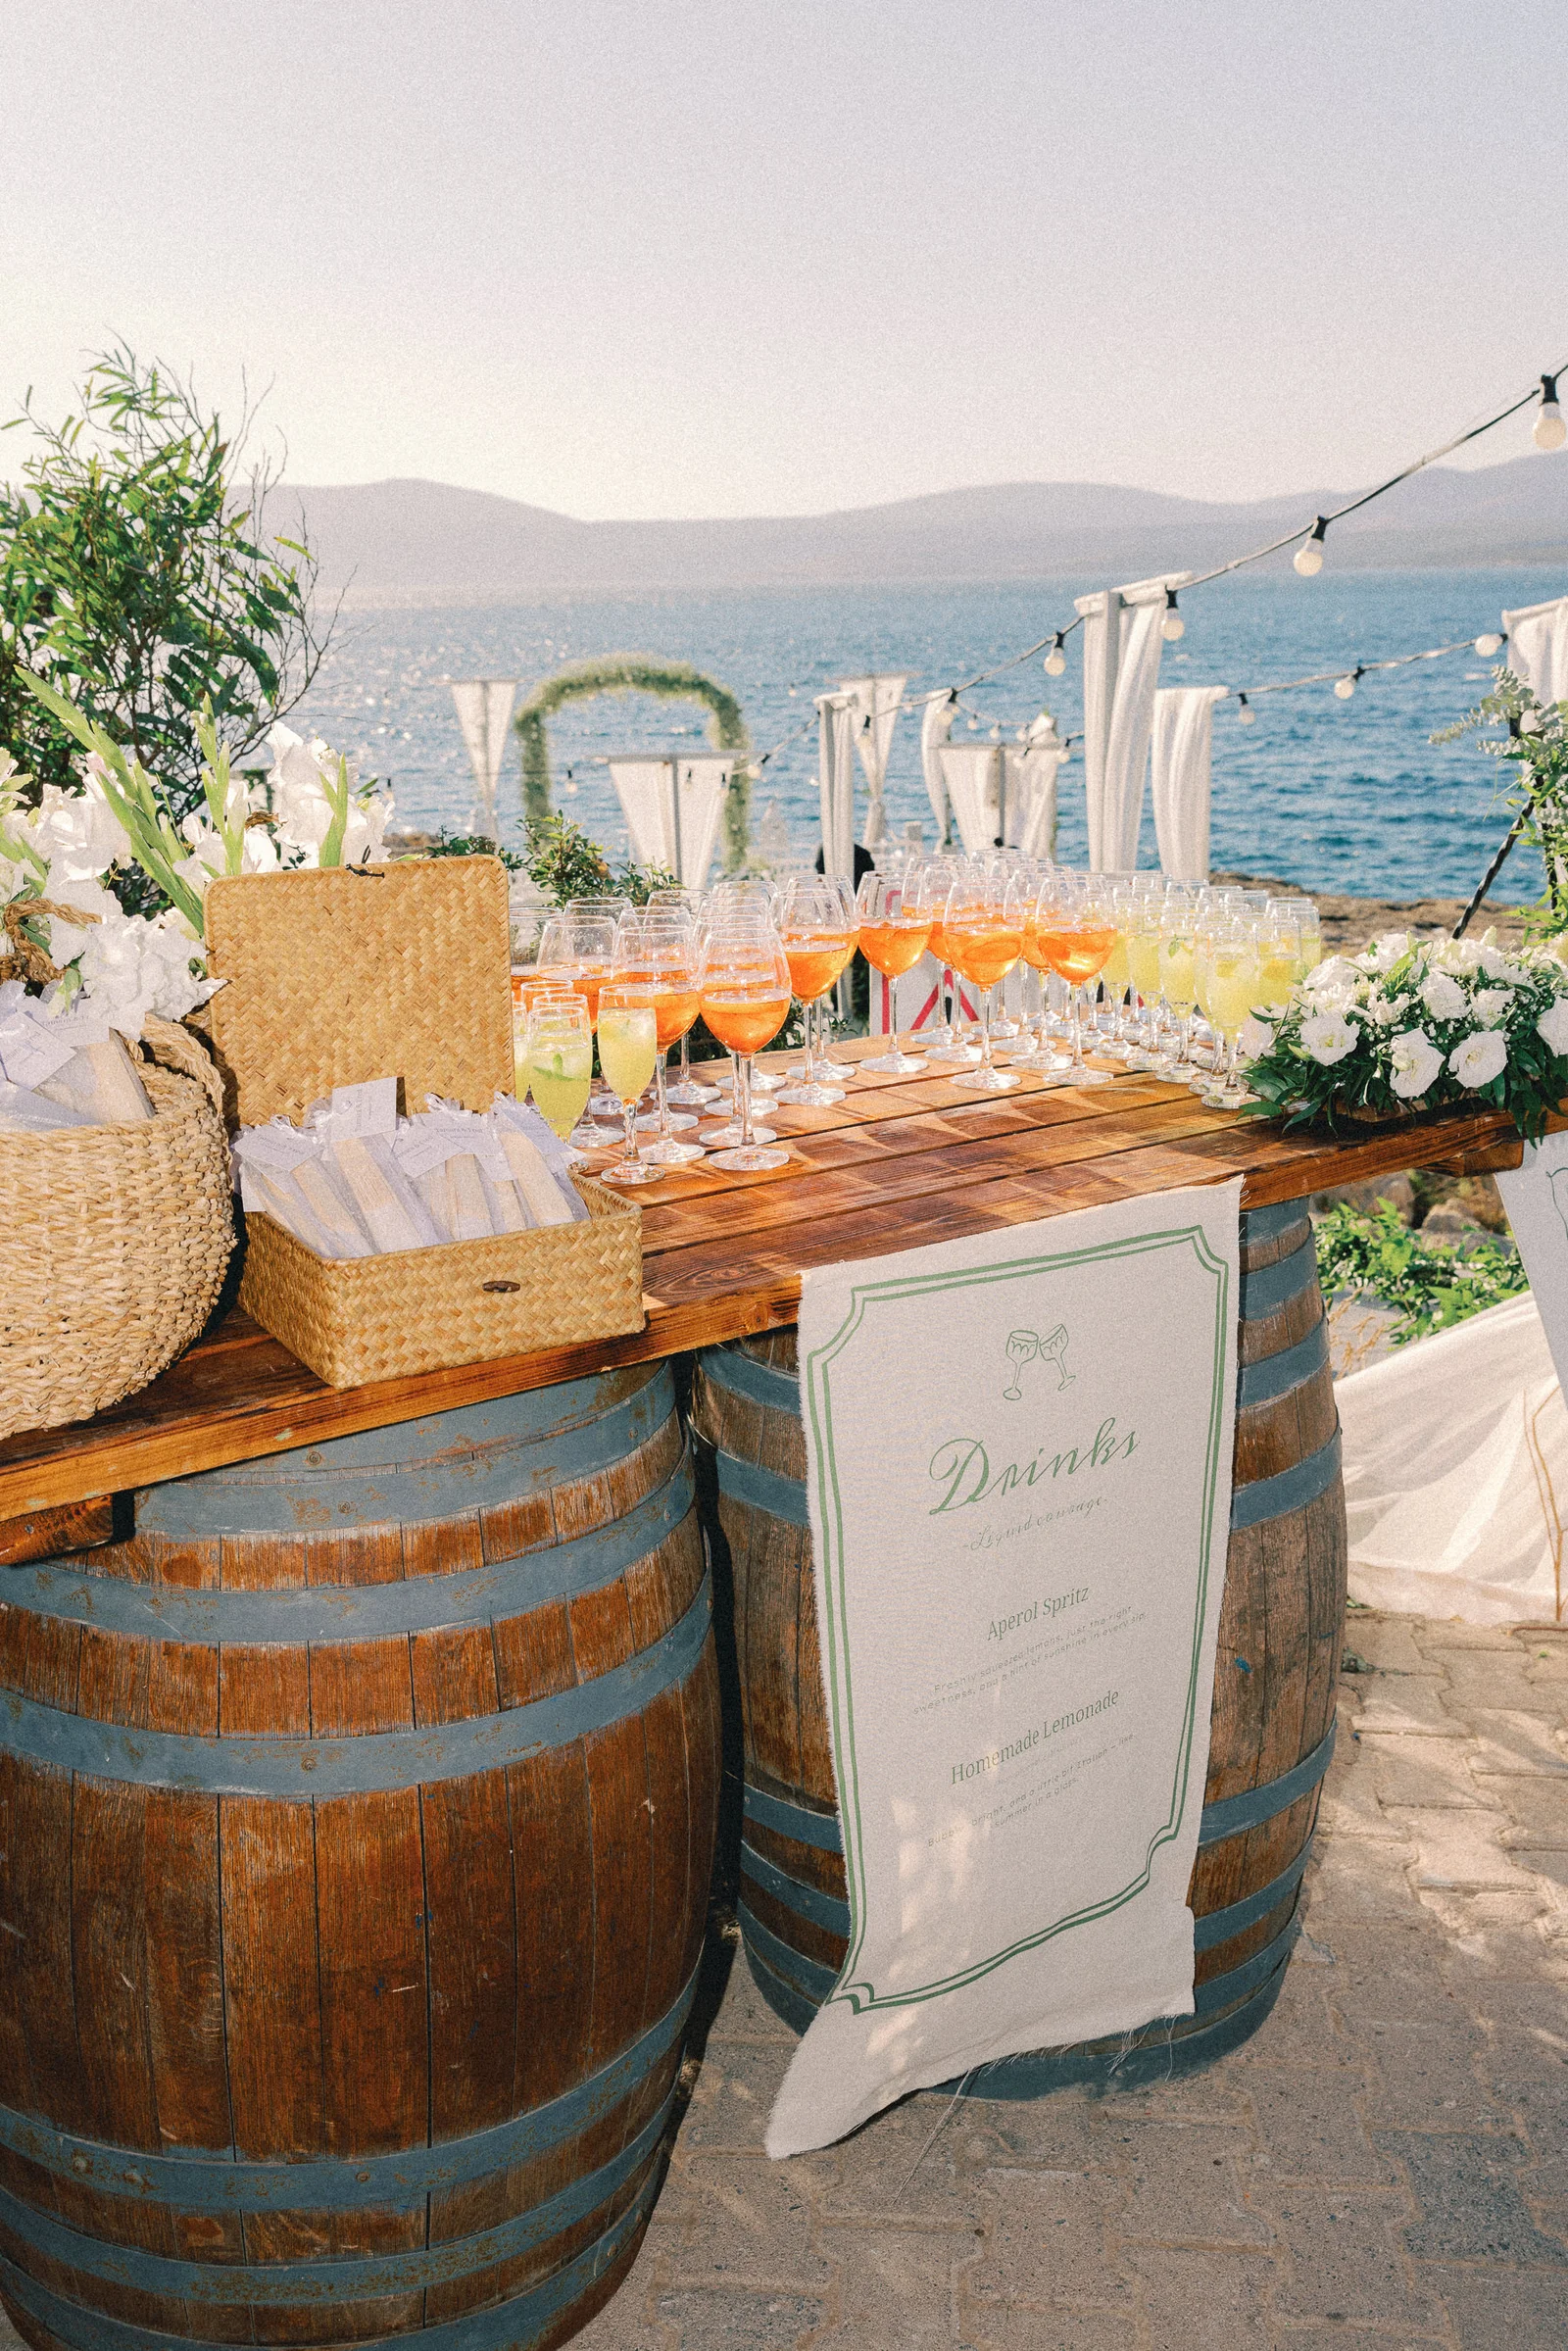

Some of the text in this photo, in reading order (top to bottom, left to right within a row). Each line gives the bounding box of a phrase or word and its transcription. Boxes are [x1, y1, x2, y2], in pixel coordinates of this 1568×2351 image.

[929, 1417, 1140, 1515] Drinks
[934, 1672, 976, 1693] Freshly
[980, 1649, 1024, 1678] squeezed
[1066, 1624, 1086, 1640] just
[1090, 1618, 1105, 1629] the
[1108, 1605, 1131, 1620] right
[987, 1587, 1089, 1641] Aperol Spritz
[979, 1677, 999, 1691] and
[1009, 1659, 1029, 1677] hint
[1044, 1638, 1088, 1661] sunshine
[1102, 1619, 1128, 1637] every
[952, 1729, 1040, 1785] Homemade
[1043, 1690, 1119, 1739] Lemonade
[1009, 1793, 1027, 1808] and
[1038, 1775, 1059, 1792] little
[1077, 1748, 1108, 1770] Italian
[994, 1802, 1033, 1828] summer
